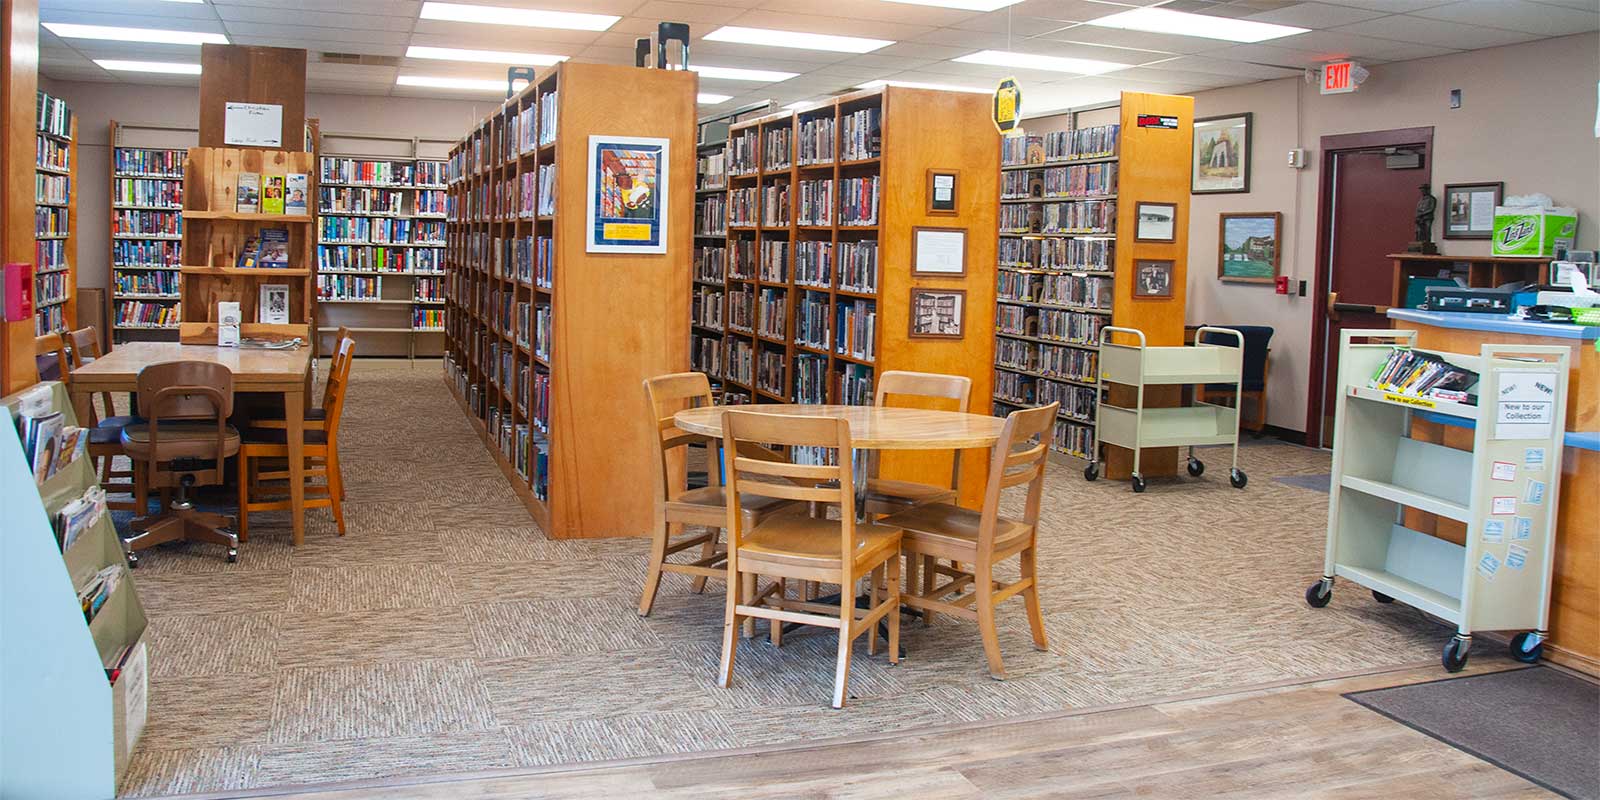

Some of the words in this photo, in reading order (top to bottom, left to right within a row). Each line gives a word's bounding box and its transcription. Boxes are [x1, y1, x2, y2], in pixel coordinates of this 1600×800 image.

[1325, 63, 1351, 90] EXIT
[1386, 394, 1396, 402] New
[1411, 398, 1433, 407] Collection
